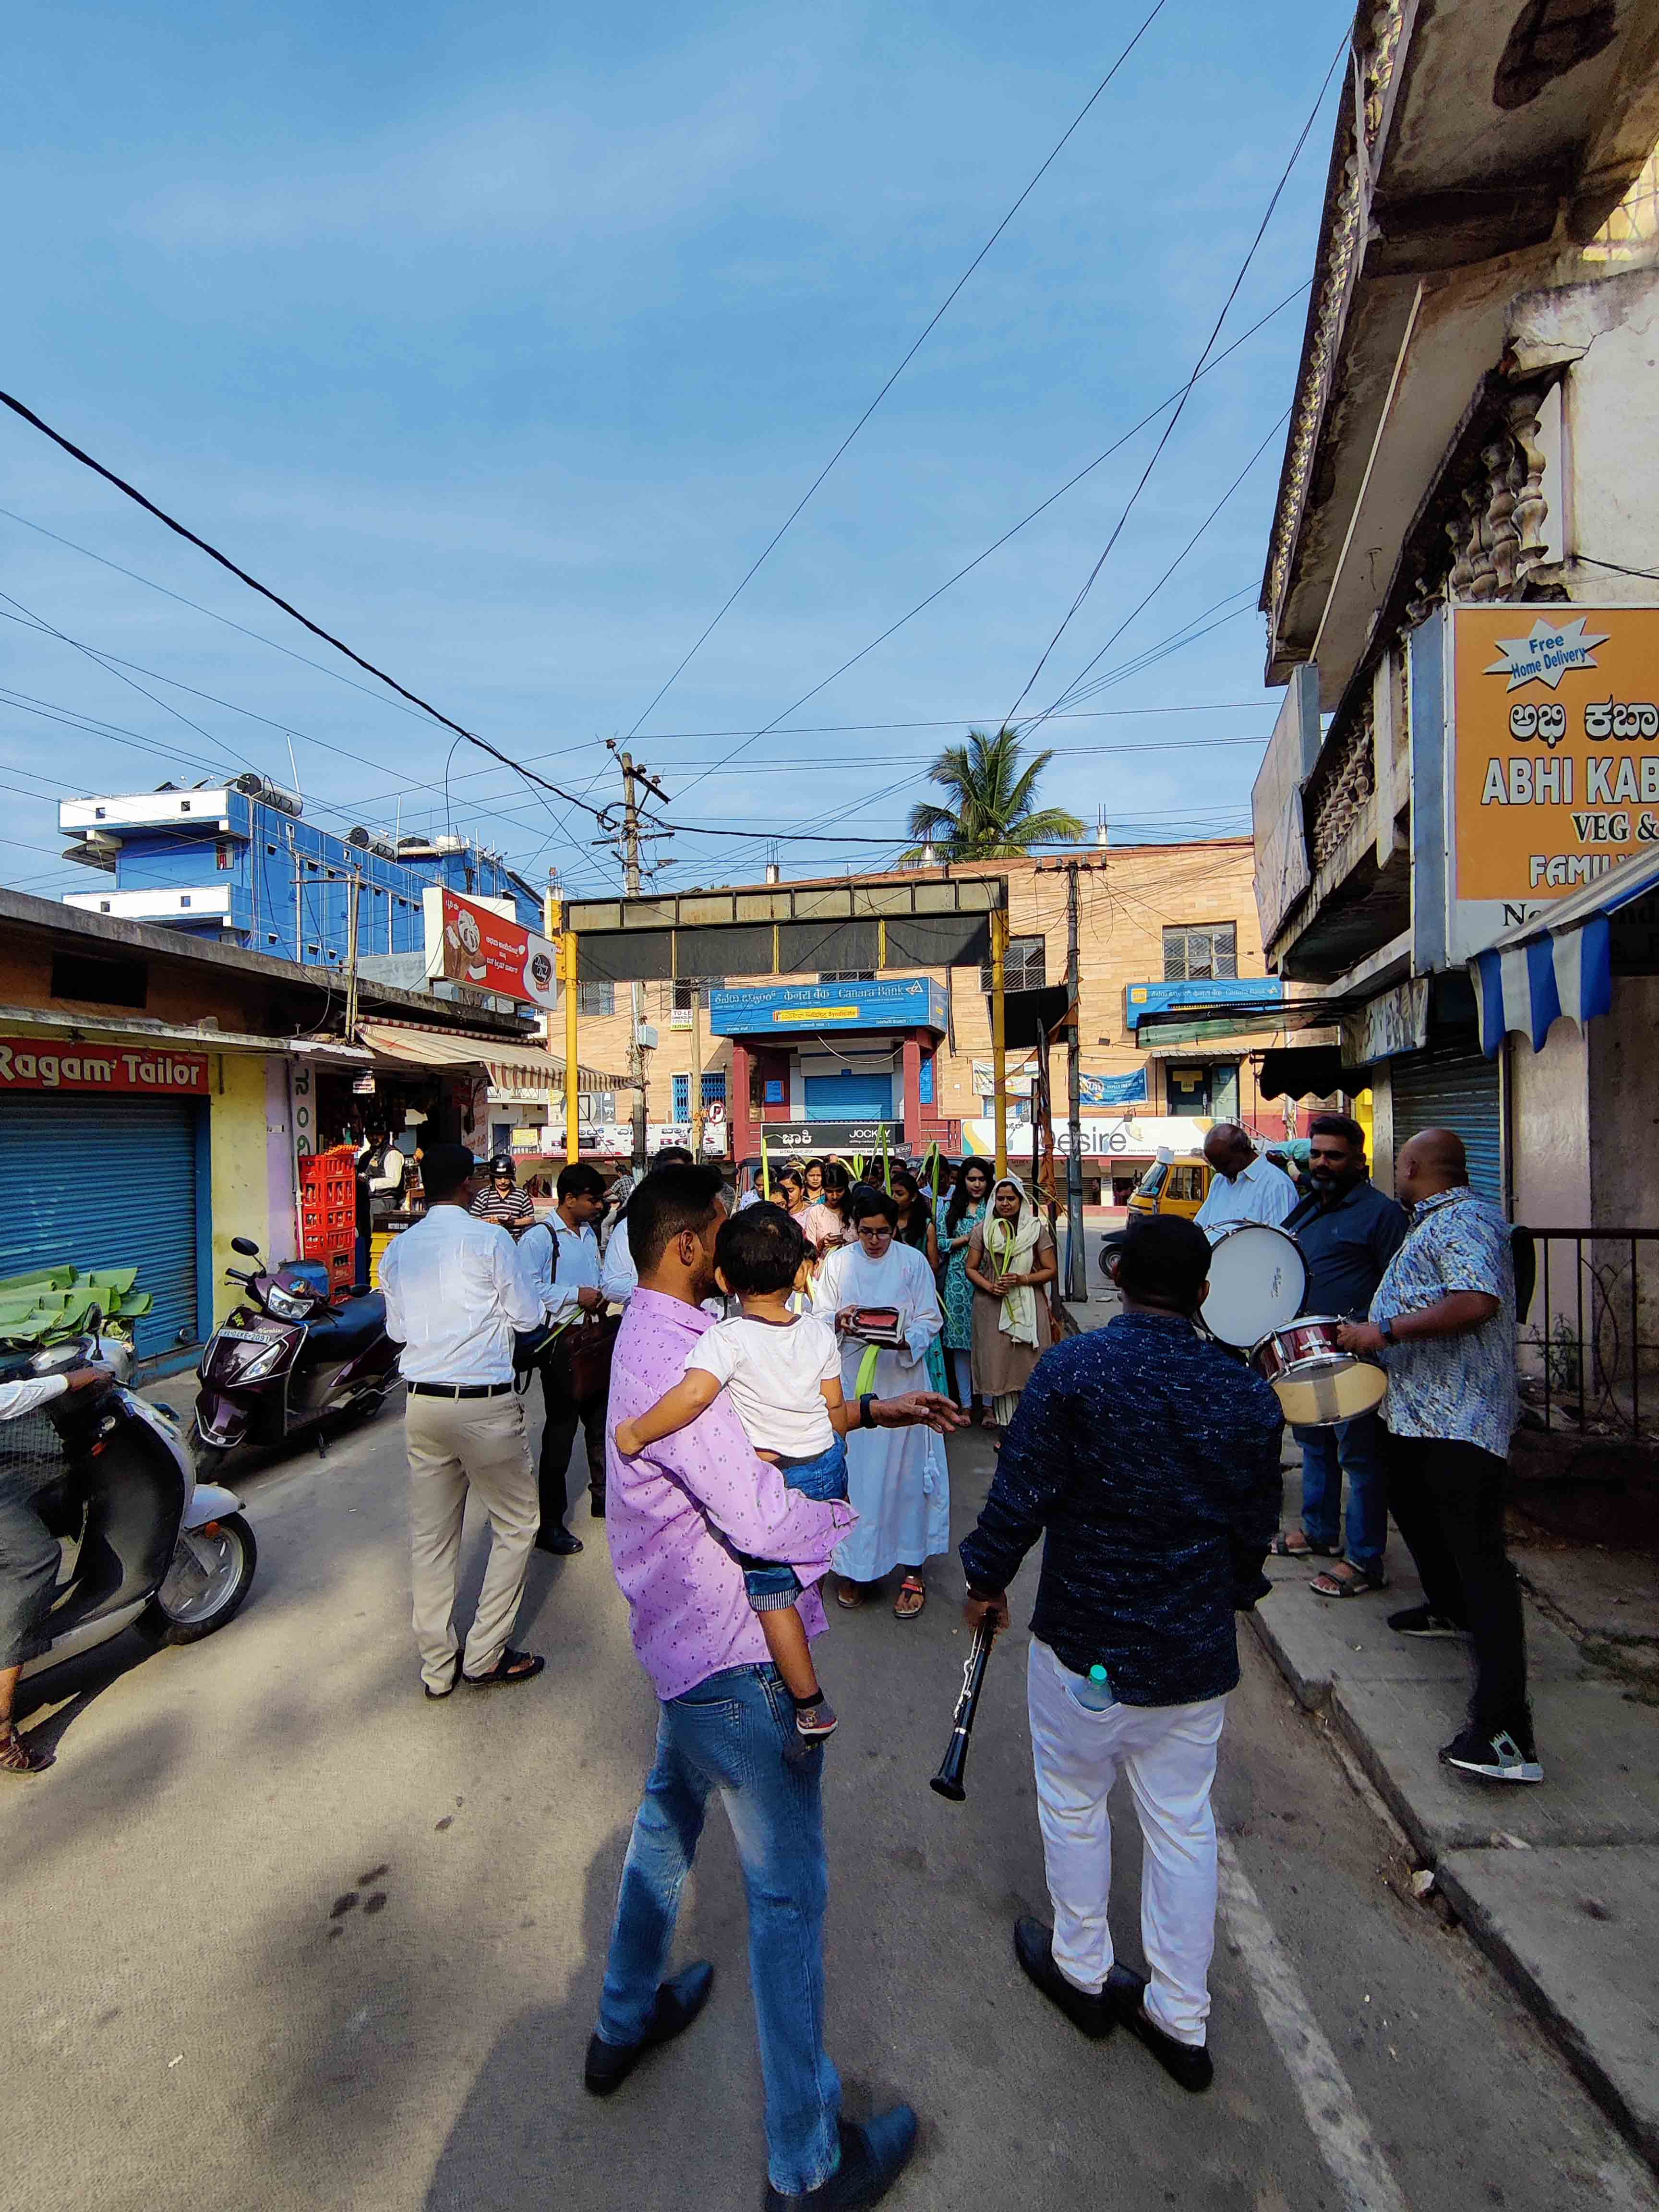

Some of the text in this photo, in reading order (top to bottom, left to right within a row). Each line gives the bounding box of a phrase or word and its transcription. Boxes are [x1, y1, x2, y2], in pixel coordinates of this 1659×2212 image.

[1529, 635, 1564, 654] Free
[1512, 647, 1587, 679] Home Delivery
[1480, 757, 1659, 805] ABHI KAB
[1572, 814, 1629, 841] VEG
[838, 985, 904, 998] Canara Bank
[122, 1055, 200, 1085] Tailor
[782, 1130, 812, 1144] ಜಾಕಿ
[849, 1130, 890, 1138] JOCKY
